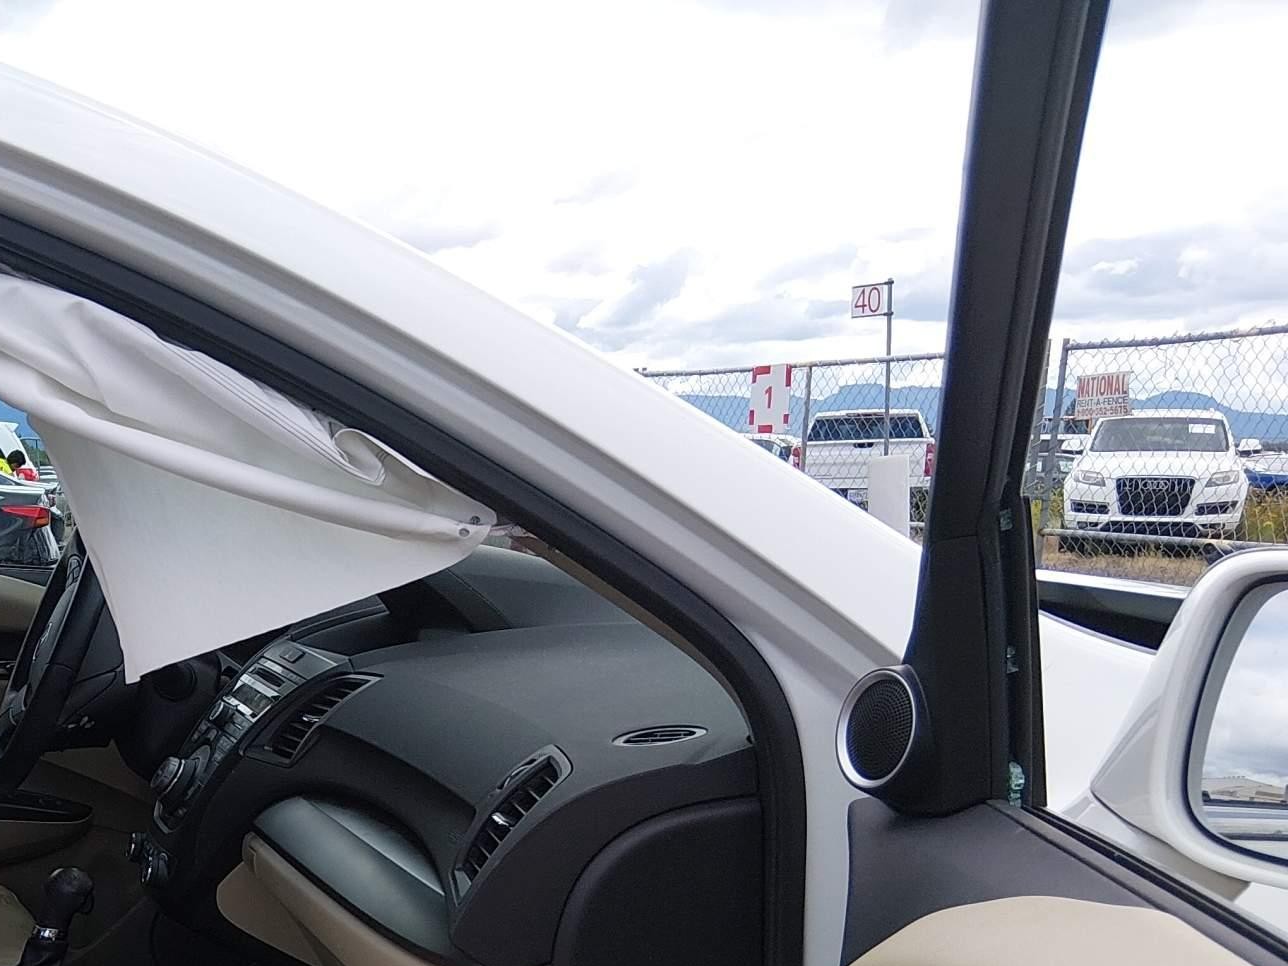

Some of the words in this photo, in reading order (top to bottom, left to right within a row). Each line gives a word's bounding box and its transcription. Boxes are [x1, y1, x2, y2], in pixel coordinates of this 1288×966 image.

[854, 286, 881, 314] 40
[764, 386, 773, 409] 1
[1078, 374, 1128, 398] NATIONAL
[1077, 396, 1128, 408] RENT-A-FENCE
